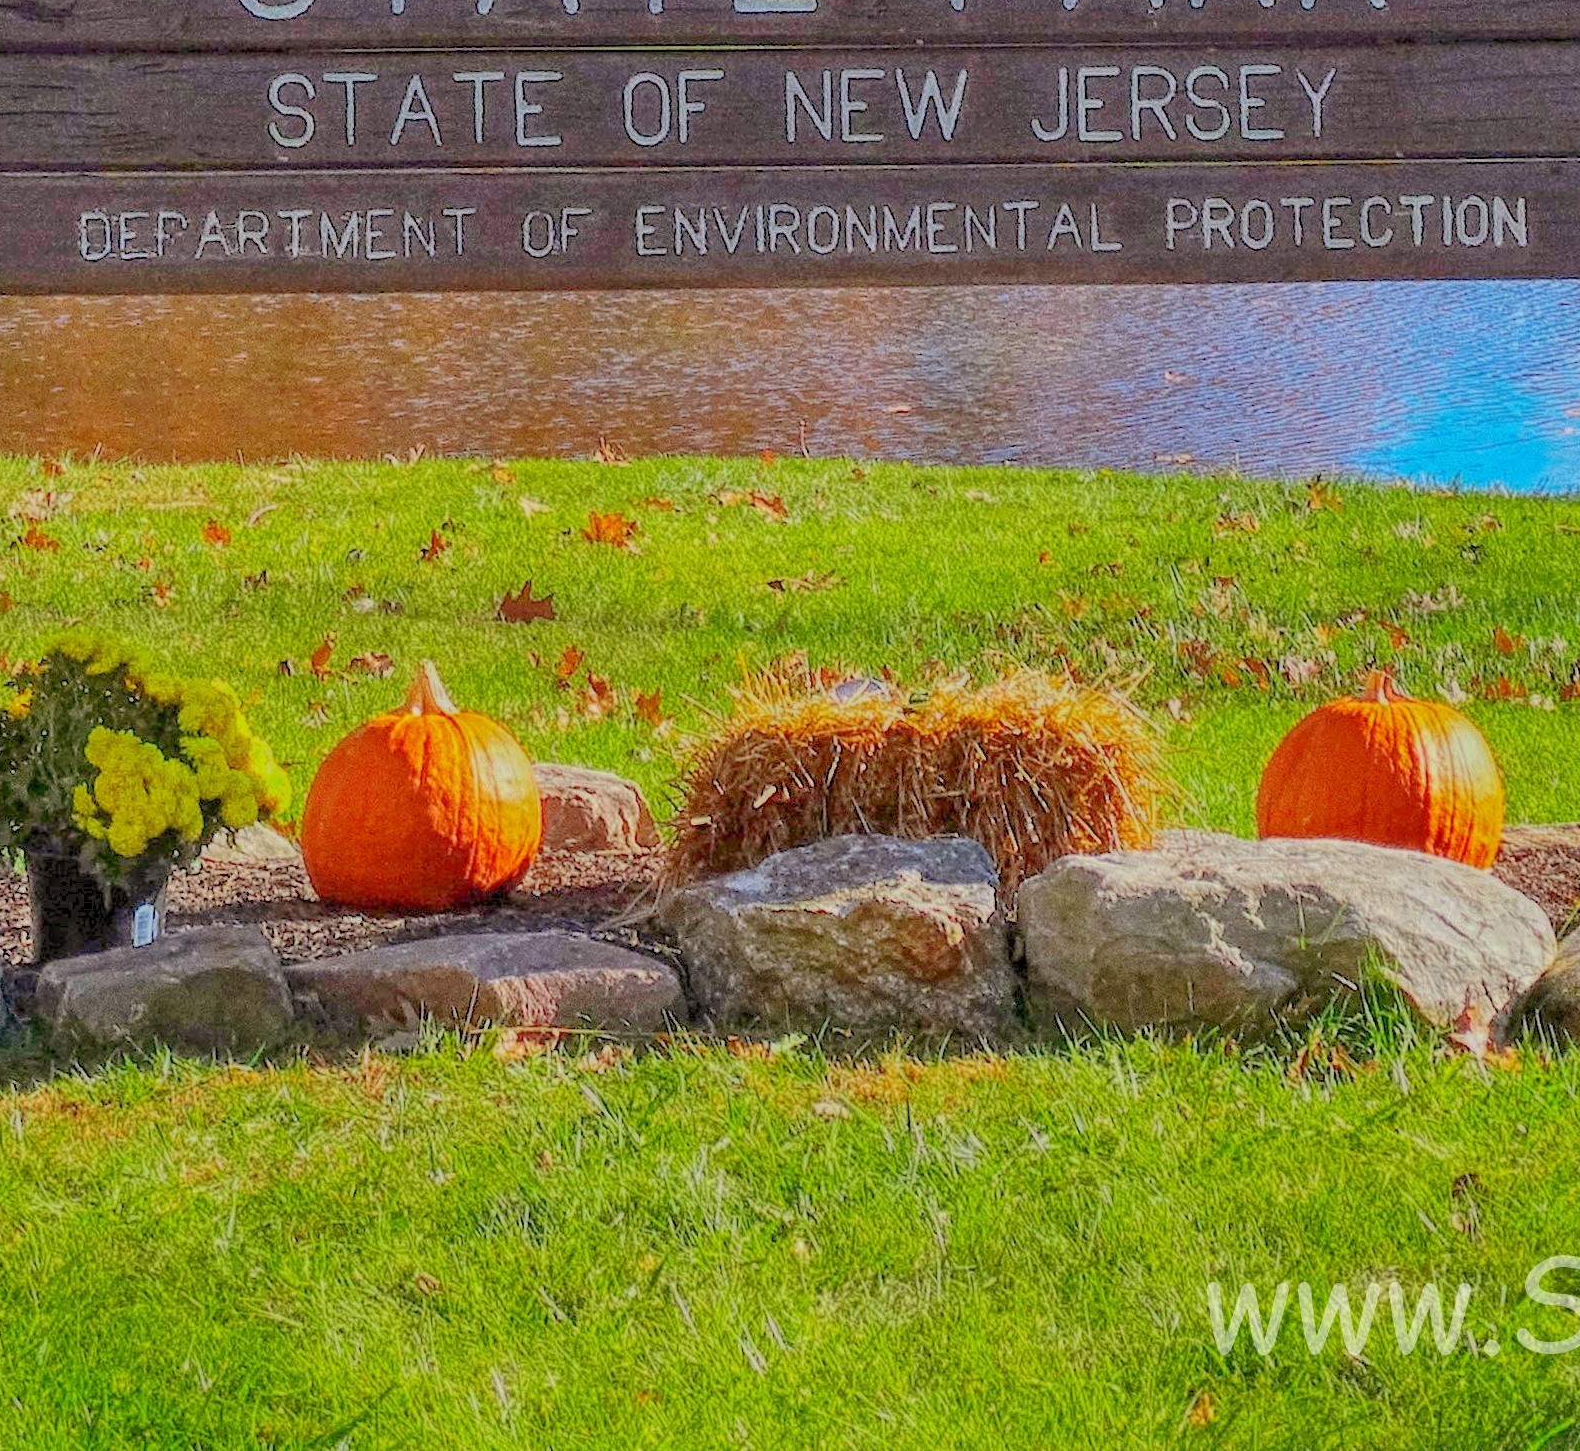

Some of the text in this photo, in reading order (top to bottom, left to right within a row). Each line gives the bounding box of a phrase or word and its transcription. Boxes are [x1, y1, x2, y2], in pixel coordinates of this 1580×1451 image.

[267, 64, 1339, 148] STATE OF NEW JERSEY
[77, 194, 1530, 261] DEPARTMENT OF ENVIRONMENTAL PROTECTION
